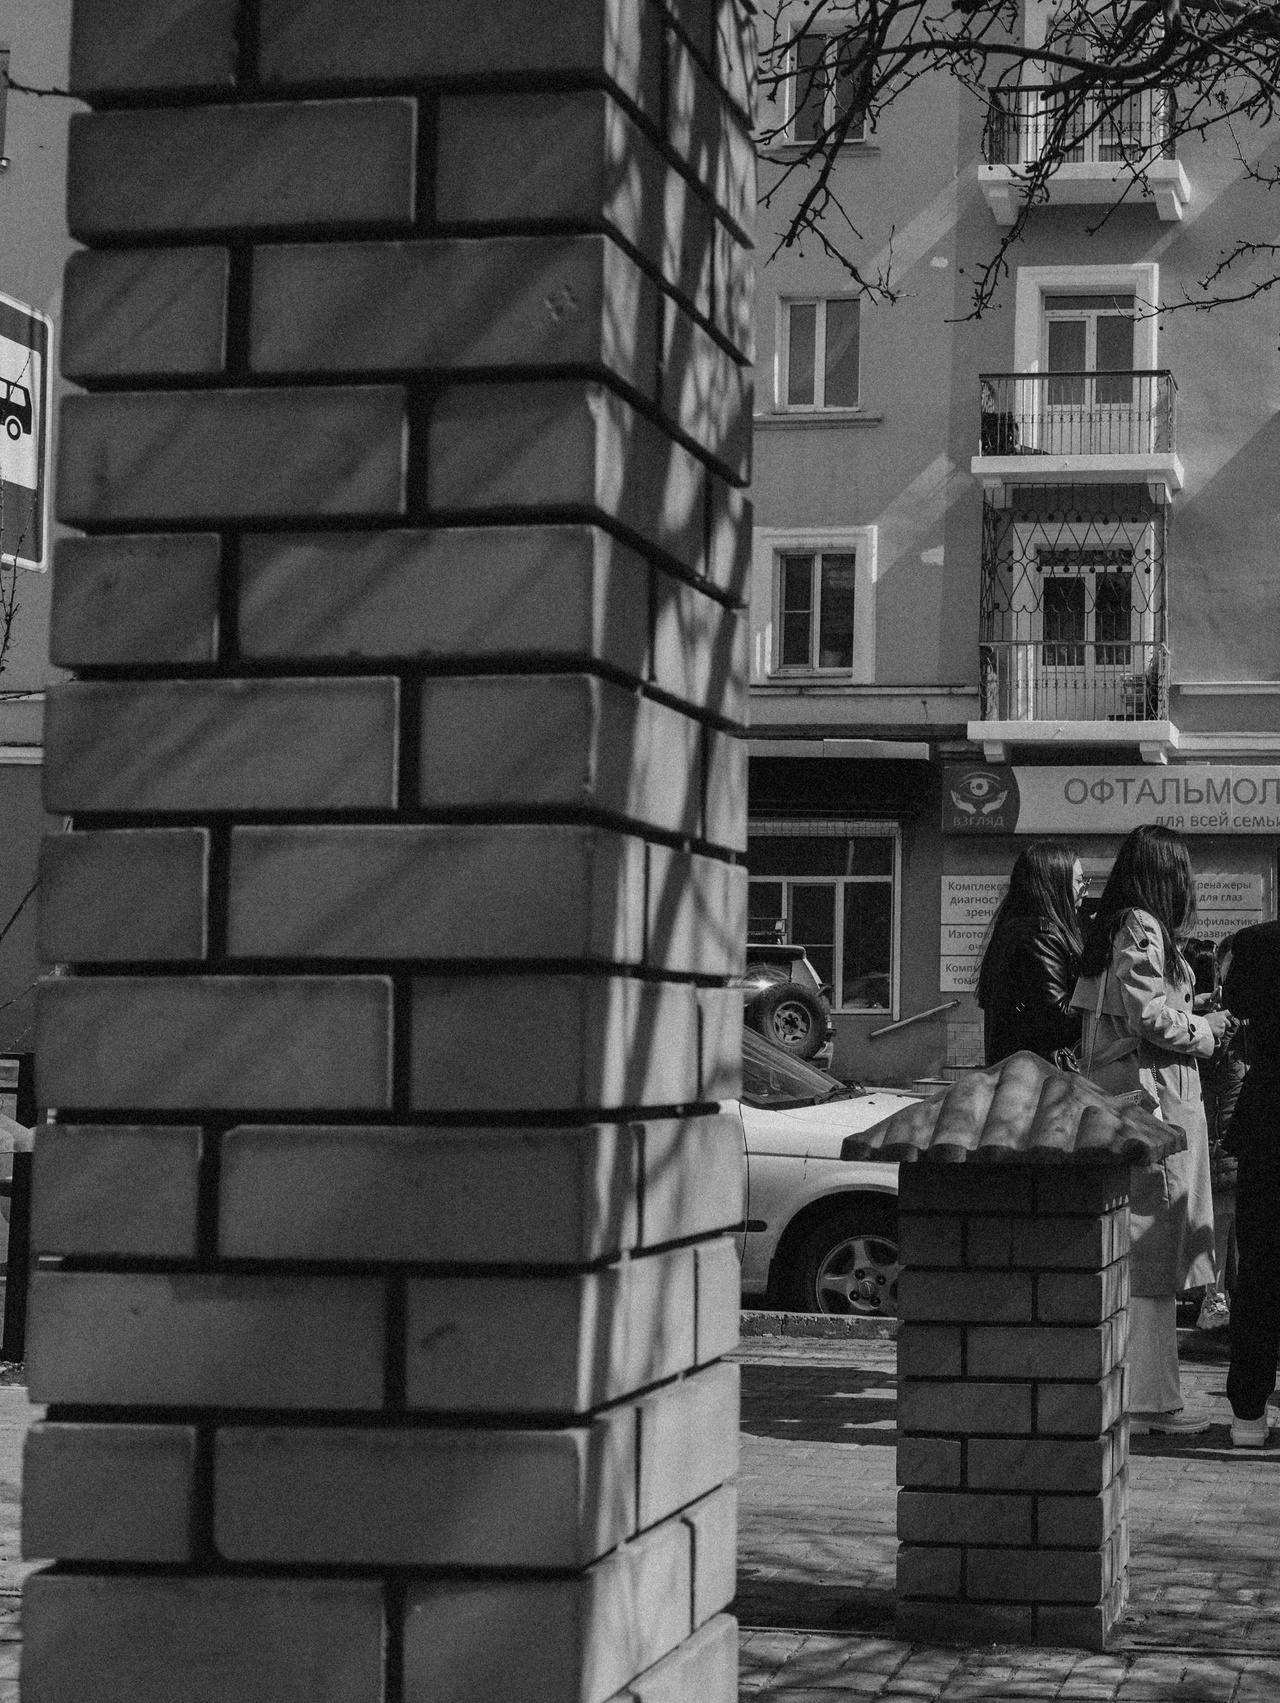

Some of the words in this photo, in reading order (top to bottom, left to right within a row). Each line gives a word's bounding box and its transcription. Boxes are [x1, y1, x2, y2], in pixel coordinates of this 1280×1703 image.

[1155, 814, 1185, 828] для
[1190, 811, 1229, 828] всей
[950, 896, 1000, 906] диагност
[1199, 894, 1218, 902] для
[1221, 894, 1243, 902] глаз
[1197, 917, 1259, 928] офилактика
